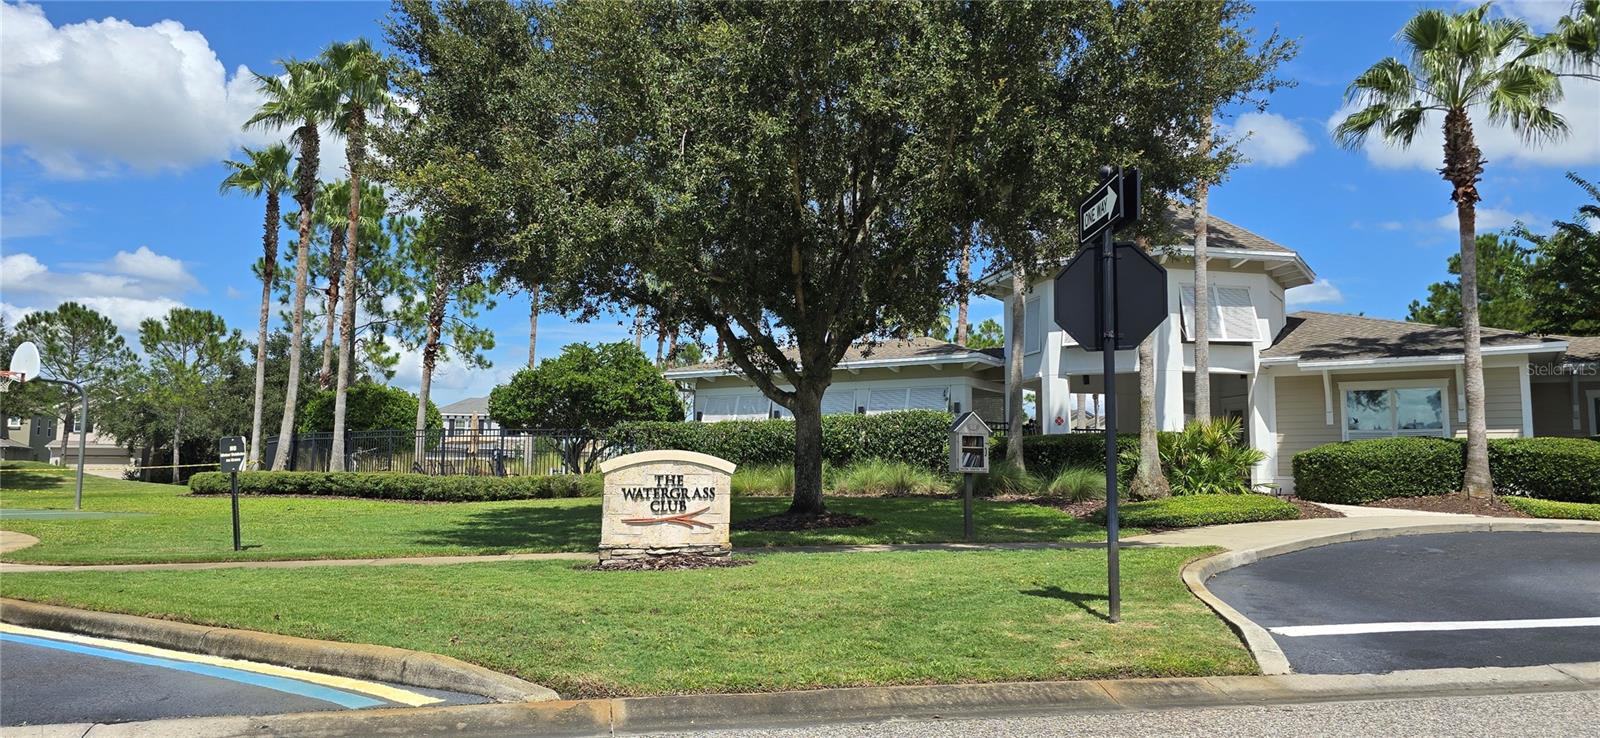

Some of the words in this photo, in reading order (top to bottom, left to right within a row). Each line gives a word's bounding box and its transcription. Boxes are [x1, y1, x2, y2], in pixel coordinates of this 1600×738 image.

[1084, 207, 1096, 228] ONE
[1097, 197, 1108, 219] WAY
[654, 474, 684, 487] THE
[621, 487, 716, 502] WATERGRASS
[650, 501, 687, 513] CLUB
